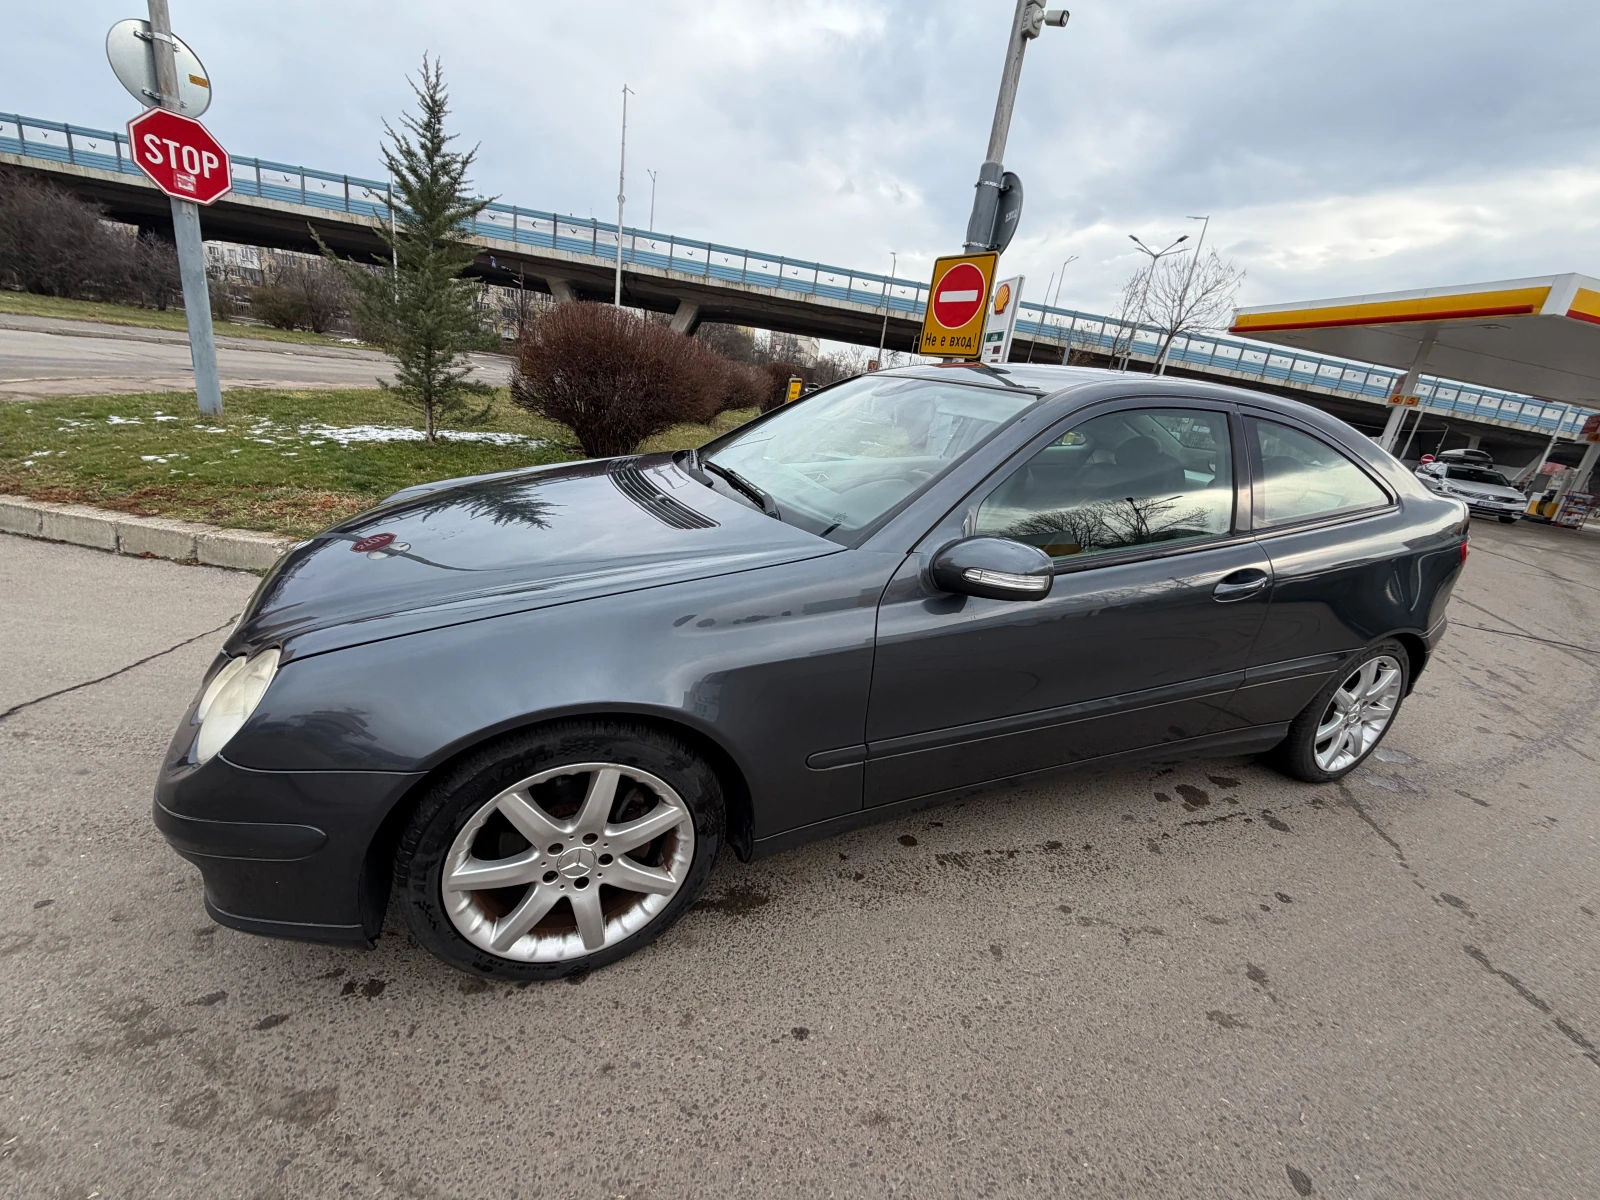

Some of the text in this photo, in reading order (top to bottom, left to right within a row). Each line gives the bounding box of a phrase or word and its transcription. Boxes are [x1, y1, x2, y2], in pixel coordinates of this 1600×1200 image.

[143, 133, 219, 179] STOP
[924, 332, 937, 346] Не
[940, 335, 946, 346] е
[949, 332, 978, 349] вход!
[1393, 395, 1400, 403] 6
[1406, 397, 1416, 405] 5
